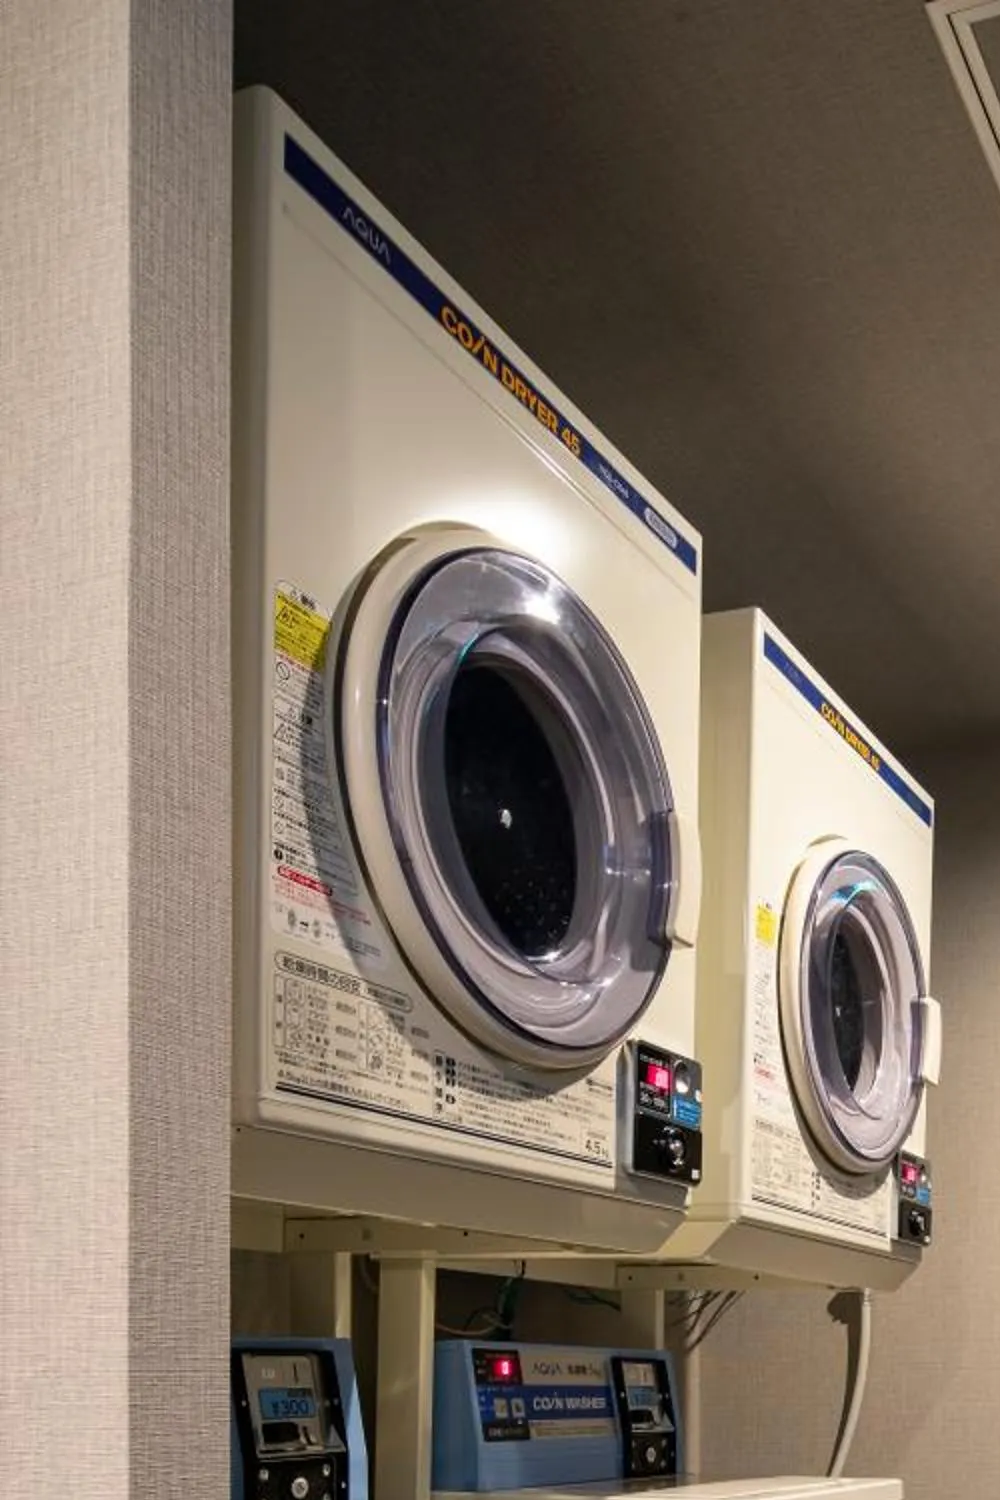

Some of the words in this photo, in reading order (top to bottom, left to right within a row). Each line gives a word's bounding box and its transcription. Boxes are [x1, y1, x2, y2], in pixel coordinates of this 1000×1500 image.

[342, 206, 391, 265] AQUA
[440, 305, 498, 374] COIN
[501, 365, 559, 433] DRYER
[561, 427, 582, 456] 45
[532, 1391, 564, 1411] COIN
